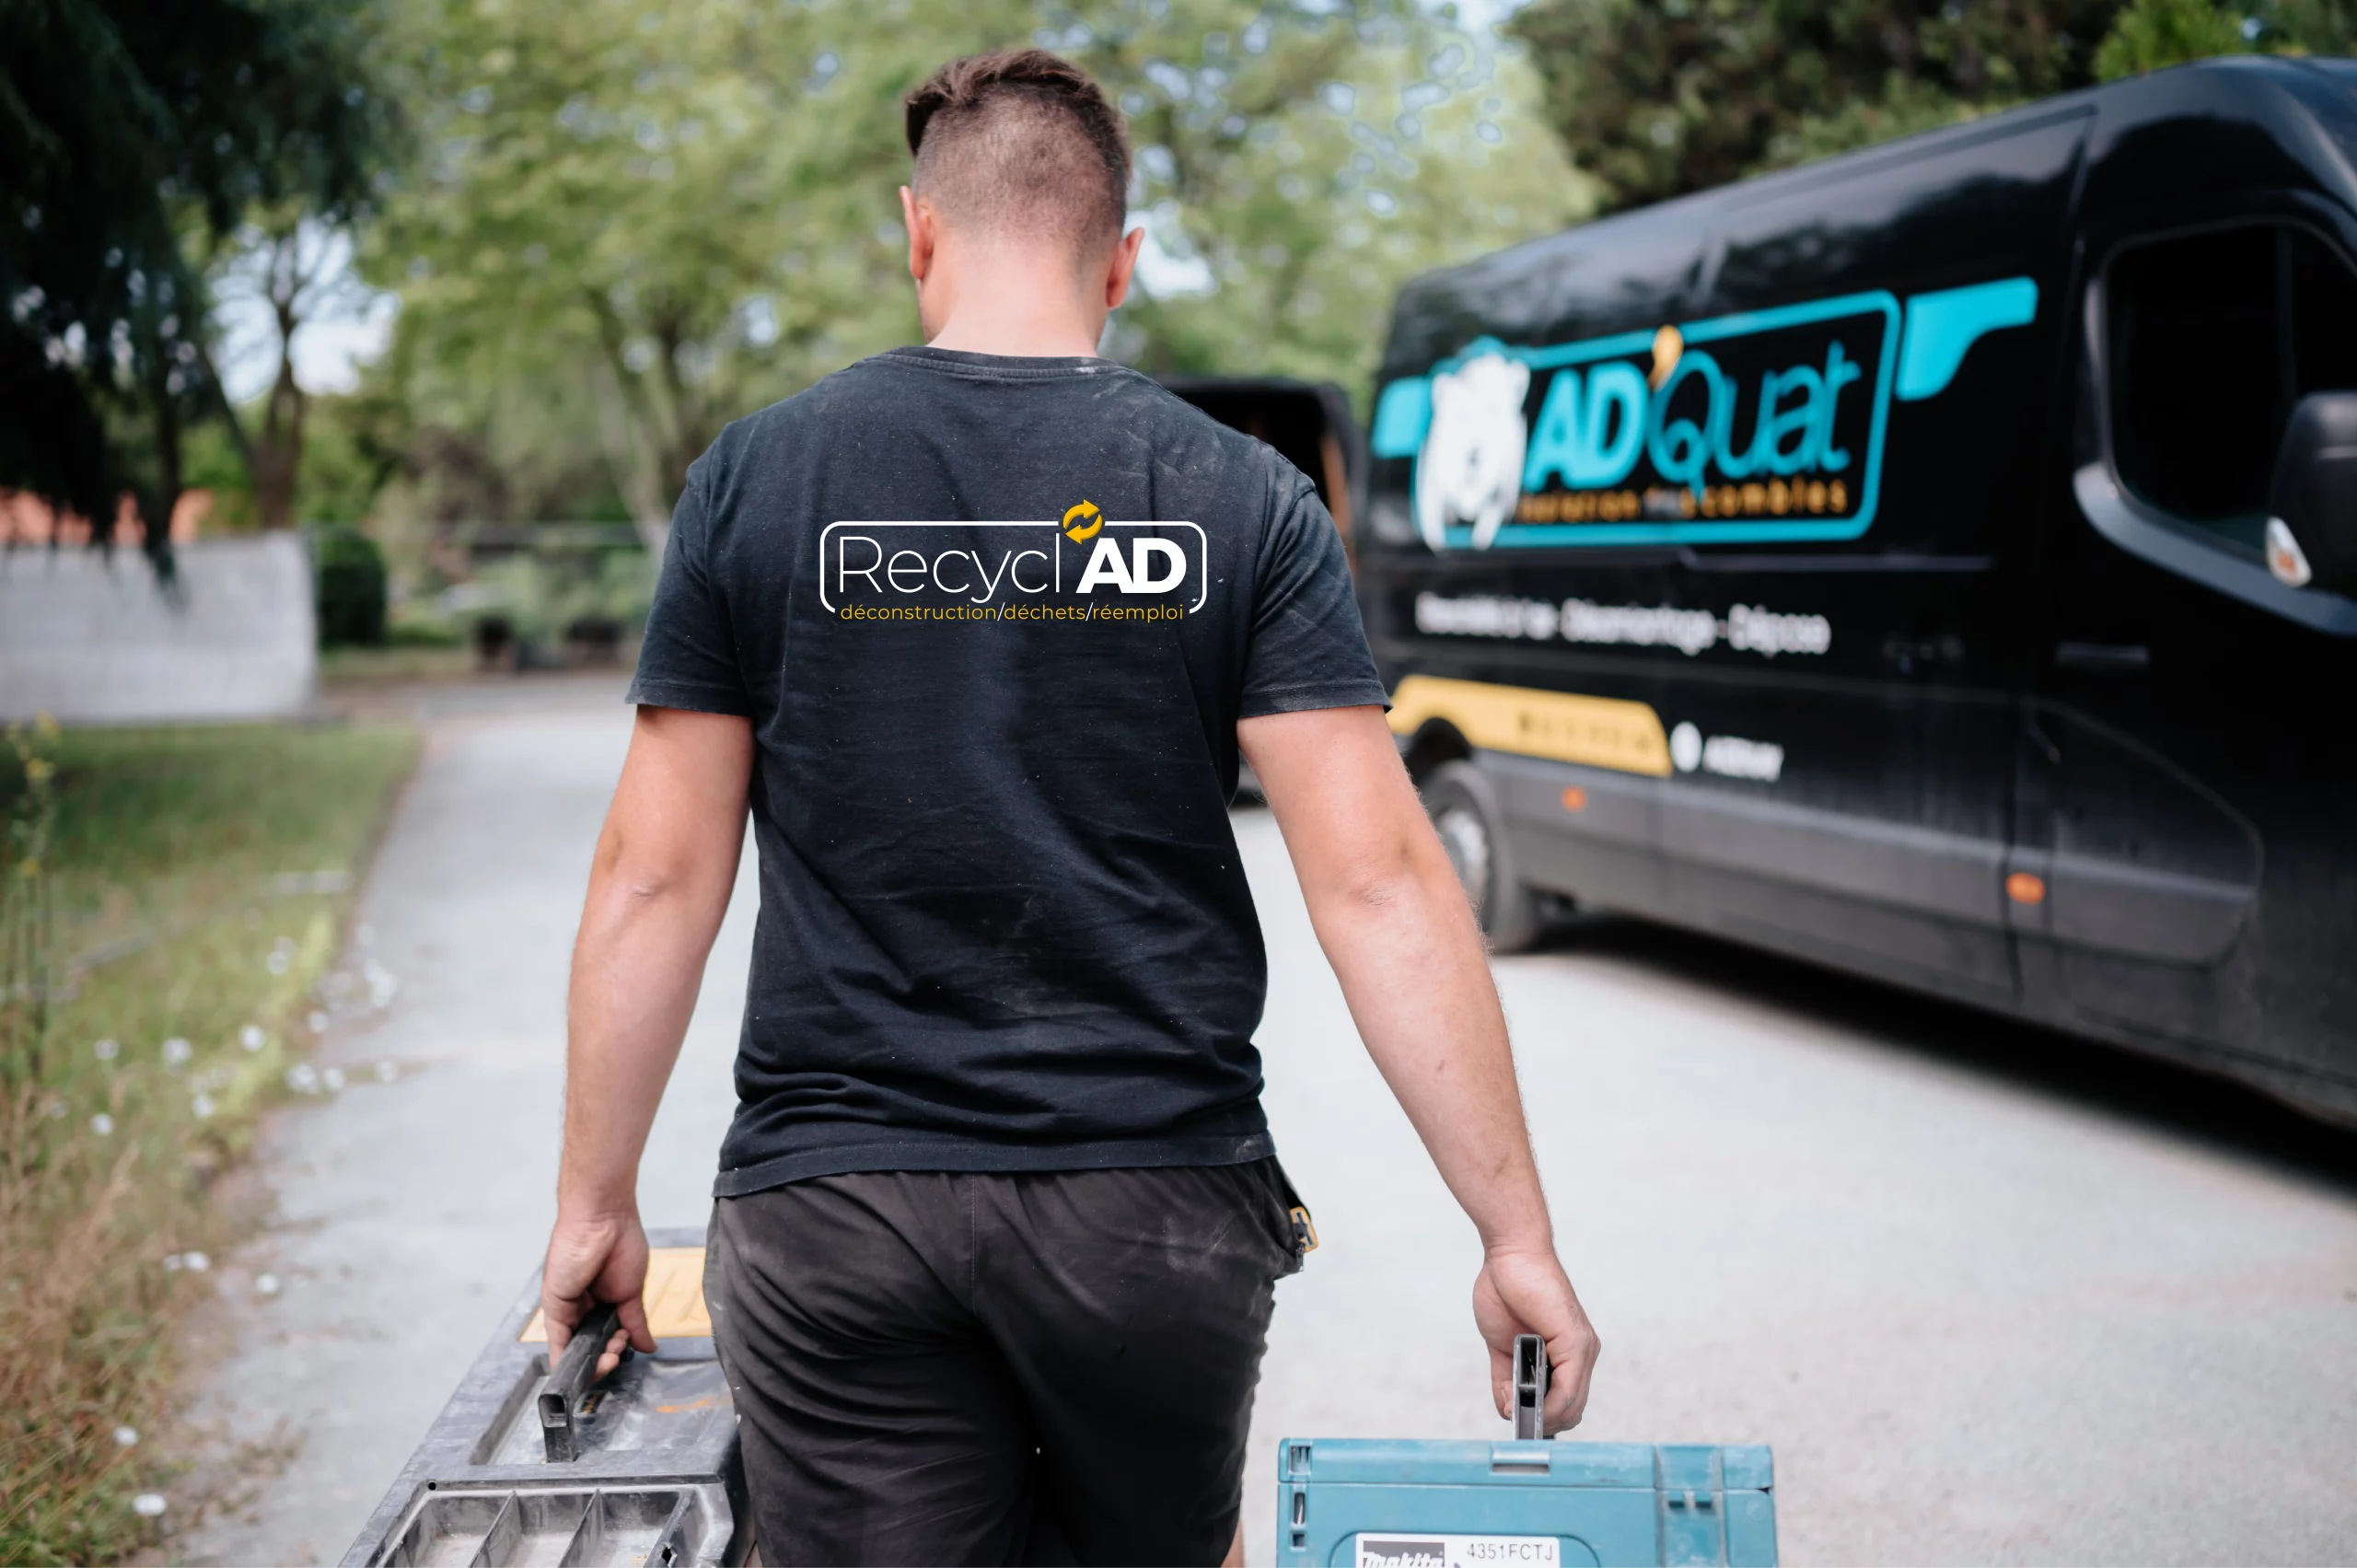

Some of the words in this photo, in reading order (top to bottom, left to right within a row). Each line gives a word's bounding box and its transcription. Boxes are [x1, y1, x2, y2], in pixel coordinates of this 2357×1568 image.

[1075, 537, 1188, 594] AD
[840, 602, 1184, 623] déconstruction/déchets/réemploi
[1467, 1542, 1553, 1561] 4351FCTJ
